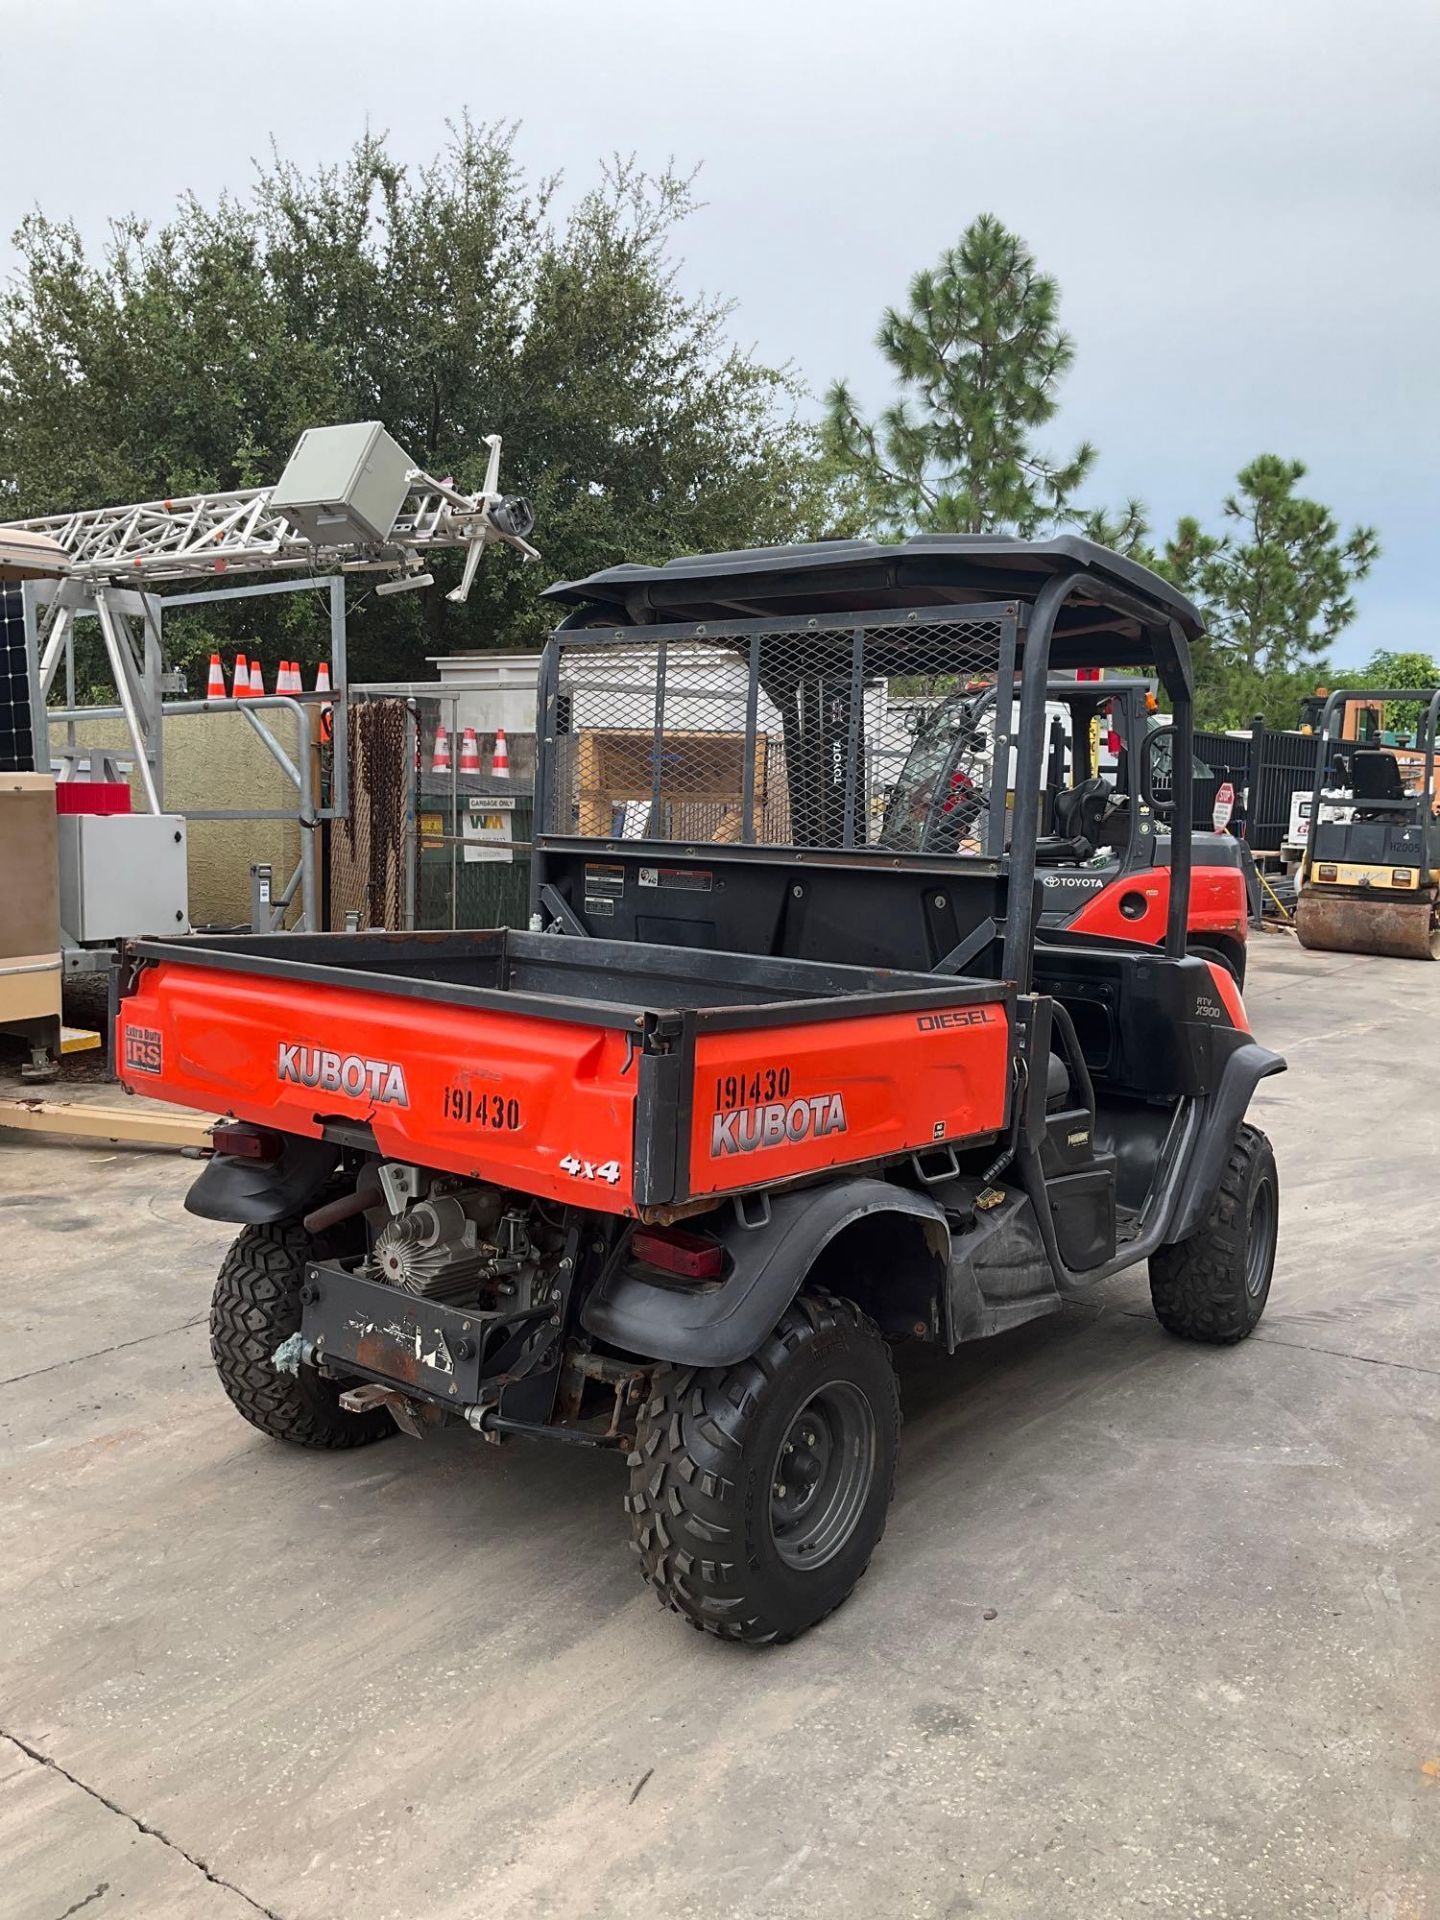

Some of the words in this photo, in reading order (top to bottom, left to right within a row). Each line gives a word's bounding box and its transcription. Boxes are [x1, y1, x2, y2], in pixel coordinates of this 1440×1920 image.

[833, 741, 842, 784] TOYOTA
[470, 815, 503, 829] WM
[1061, 878, 1103, 888] TOYOTA
[1195, 1005, 1220, 1018] X900
[1197, 997, 1212, 1006] RTV
[917, 1009, 996, 1032] DIESEL
[127, 1039, 161, 1066] IRS
[278, 1042, 409, 1106] KUBOTA
[716, 1067, 791, 1111] 191430
[443, 1086, 519, 1130] 191430
[711, 1092, 847, 1158] KUBOTA
[559, 1154, 621, 1185] 4x4
